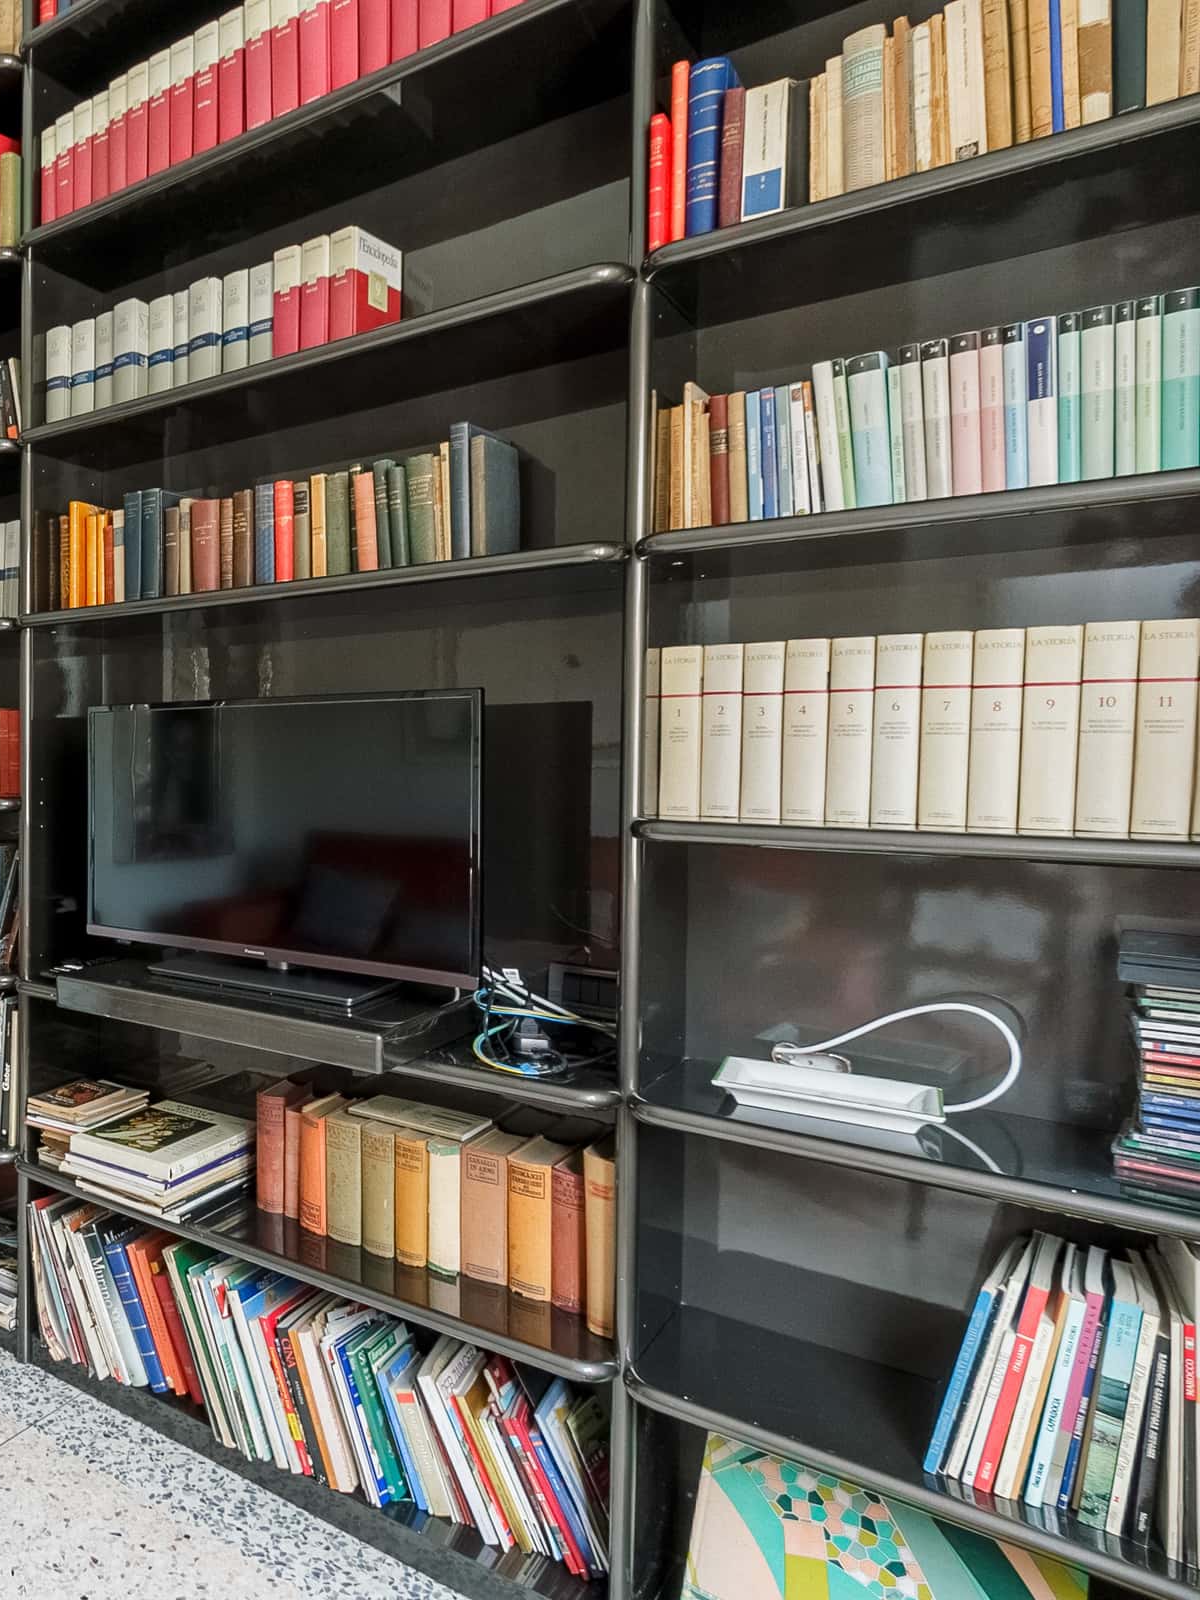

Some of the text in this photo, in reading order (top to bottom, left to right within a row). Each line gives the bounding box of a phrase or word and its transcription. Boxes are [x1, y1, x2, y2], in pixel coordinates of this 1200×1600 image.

[891, 702, 900, 712] 6
[943, 701, 951, 712] 7
[992, 701, 1002, 712] 8
[1046, 699, 1055, 710] 9
[1099, 696, 1117, 708] 10
[1159, 696, 1173, 708] 11
[676, 708, 681, 718] 1
[717, 705, 726, 716] 2
[759, 706, 766, 717] 3
[798, 705, 806, 715] 4
[847, 703, 854, 714] 5
[91, 1256, 112, 1308] Murano
[281, 1338, 296, 1369] CINA
[1184, 1358, 1196, 1397] MAROCCO
